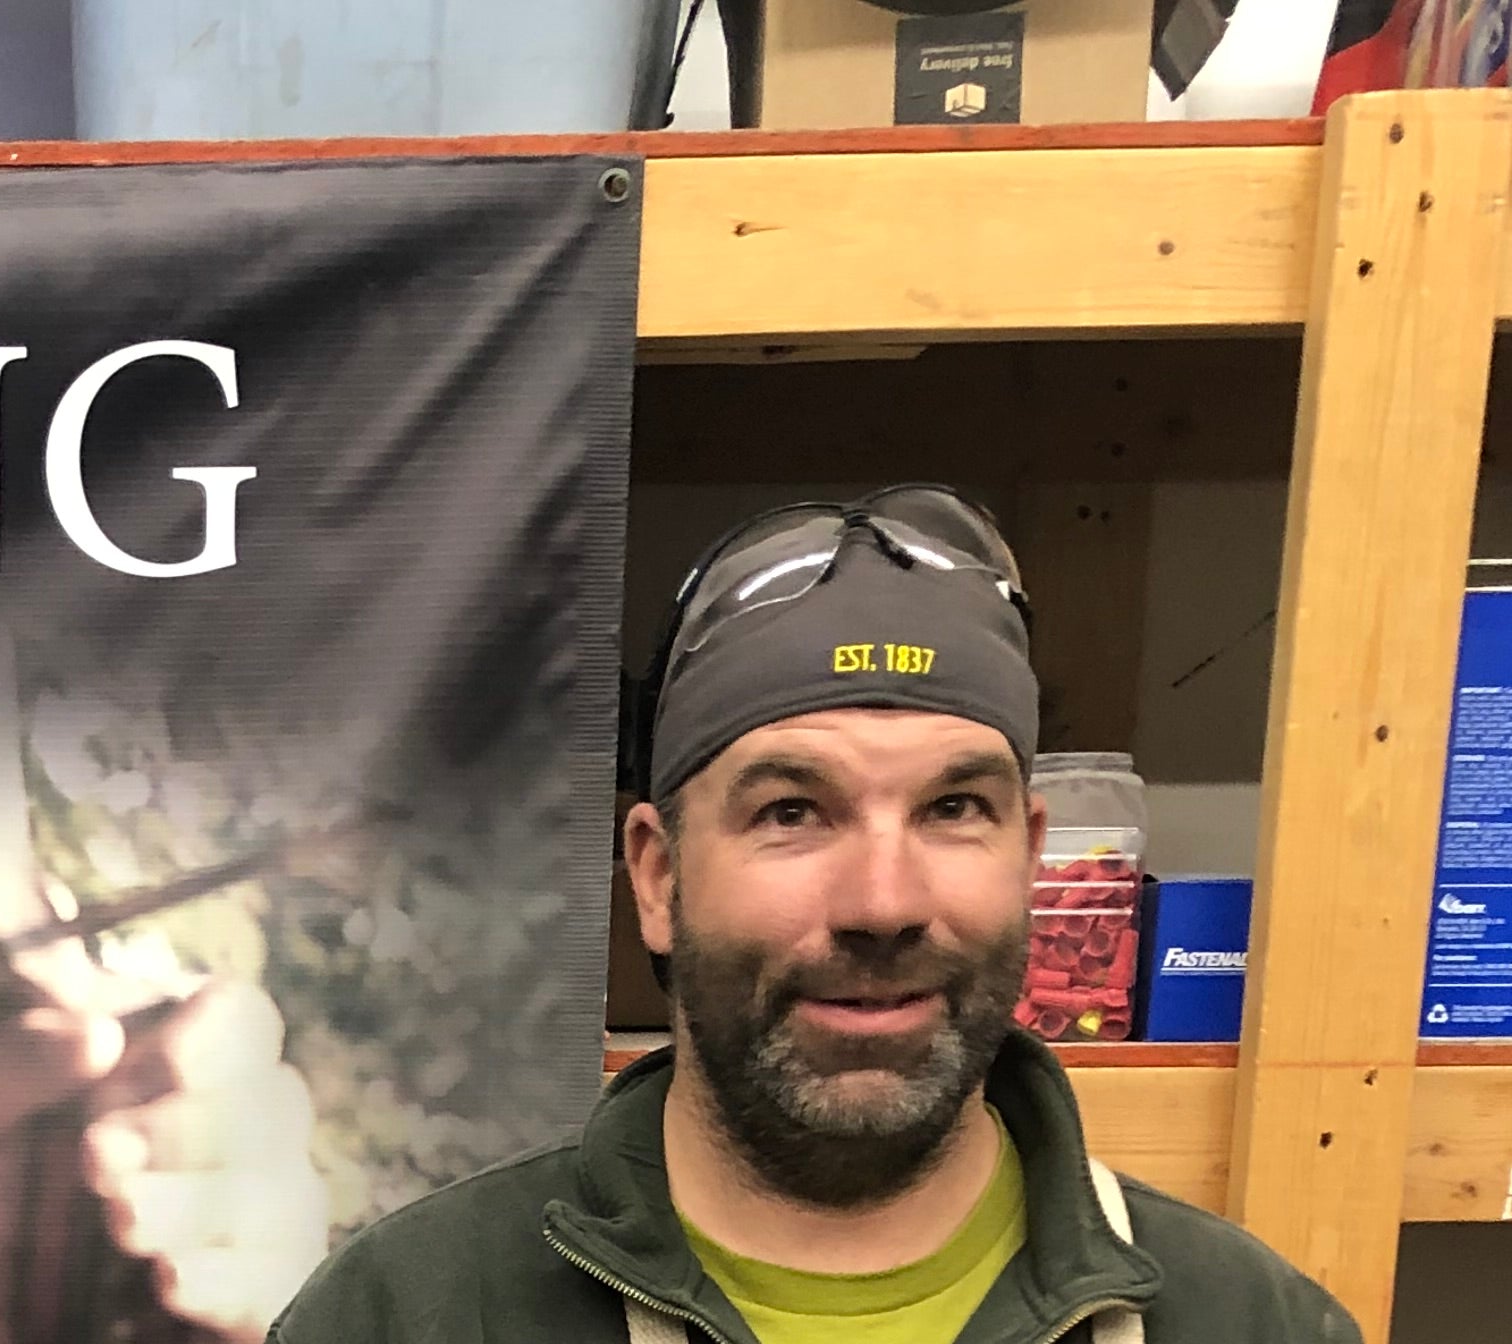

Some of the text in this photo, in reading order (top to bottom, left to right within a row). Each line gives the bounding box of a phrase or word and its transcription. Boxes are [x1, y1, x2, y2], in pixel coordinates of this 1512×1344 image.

[920, 56, 980, 73] delivery
[834, 643, 937, 674] EST. 1837
